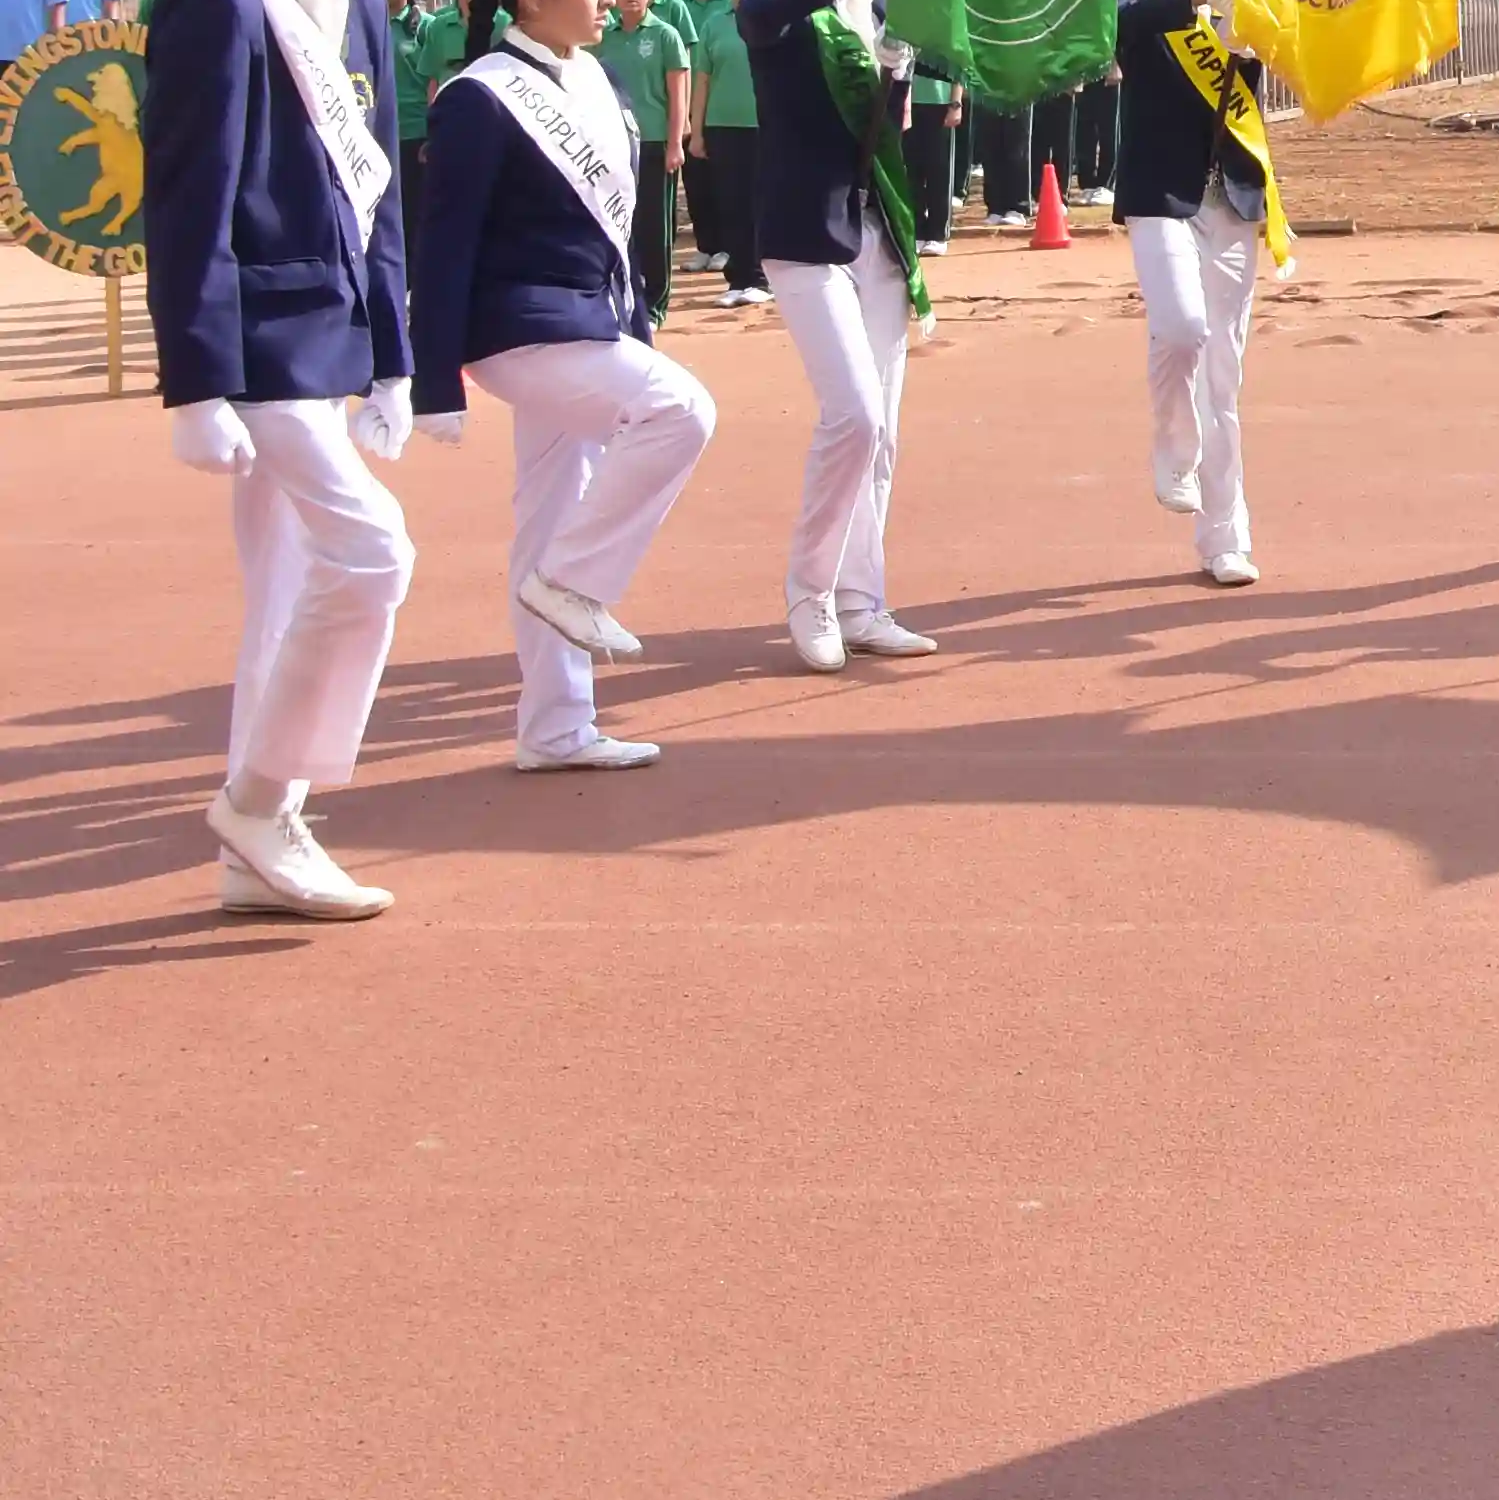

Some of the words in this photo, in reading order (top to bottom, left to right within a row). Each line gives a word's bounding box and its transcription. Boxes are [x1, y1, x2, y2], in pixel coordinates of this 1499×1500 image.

[1184, 30, 1250, 120] CAPTIN
[505, 75, 610, 187] DISCIPLINE
[44, 231, 103, 276] THE
